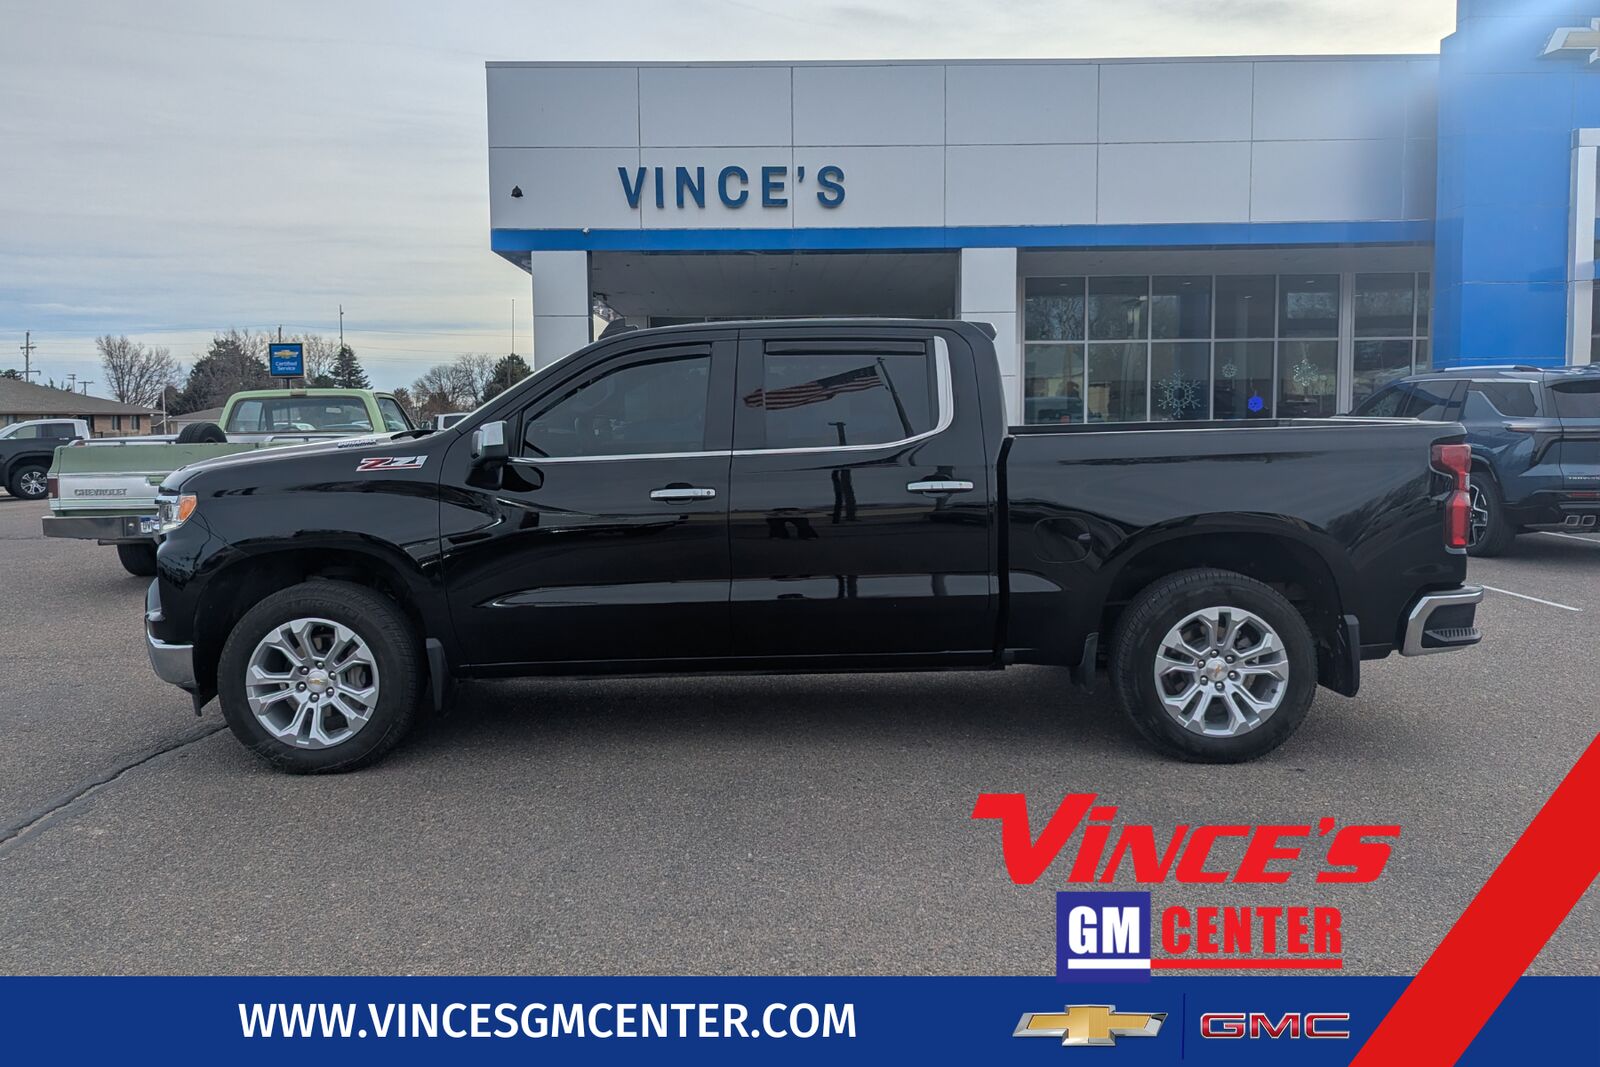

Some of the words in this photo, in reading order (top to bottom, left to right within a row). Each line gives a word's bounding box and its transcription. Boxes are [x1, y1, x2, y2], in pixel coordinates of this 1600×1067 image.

[618, 165, 846, 209] VINCE'S
[356, 455, 428, 472] Z71
[74, 488, 128, 496] CHEVROLET
